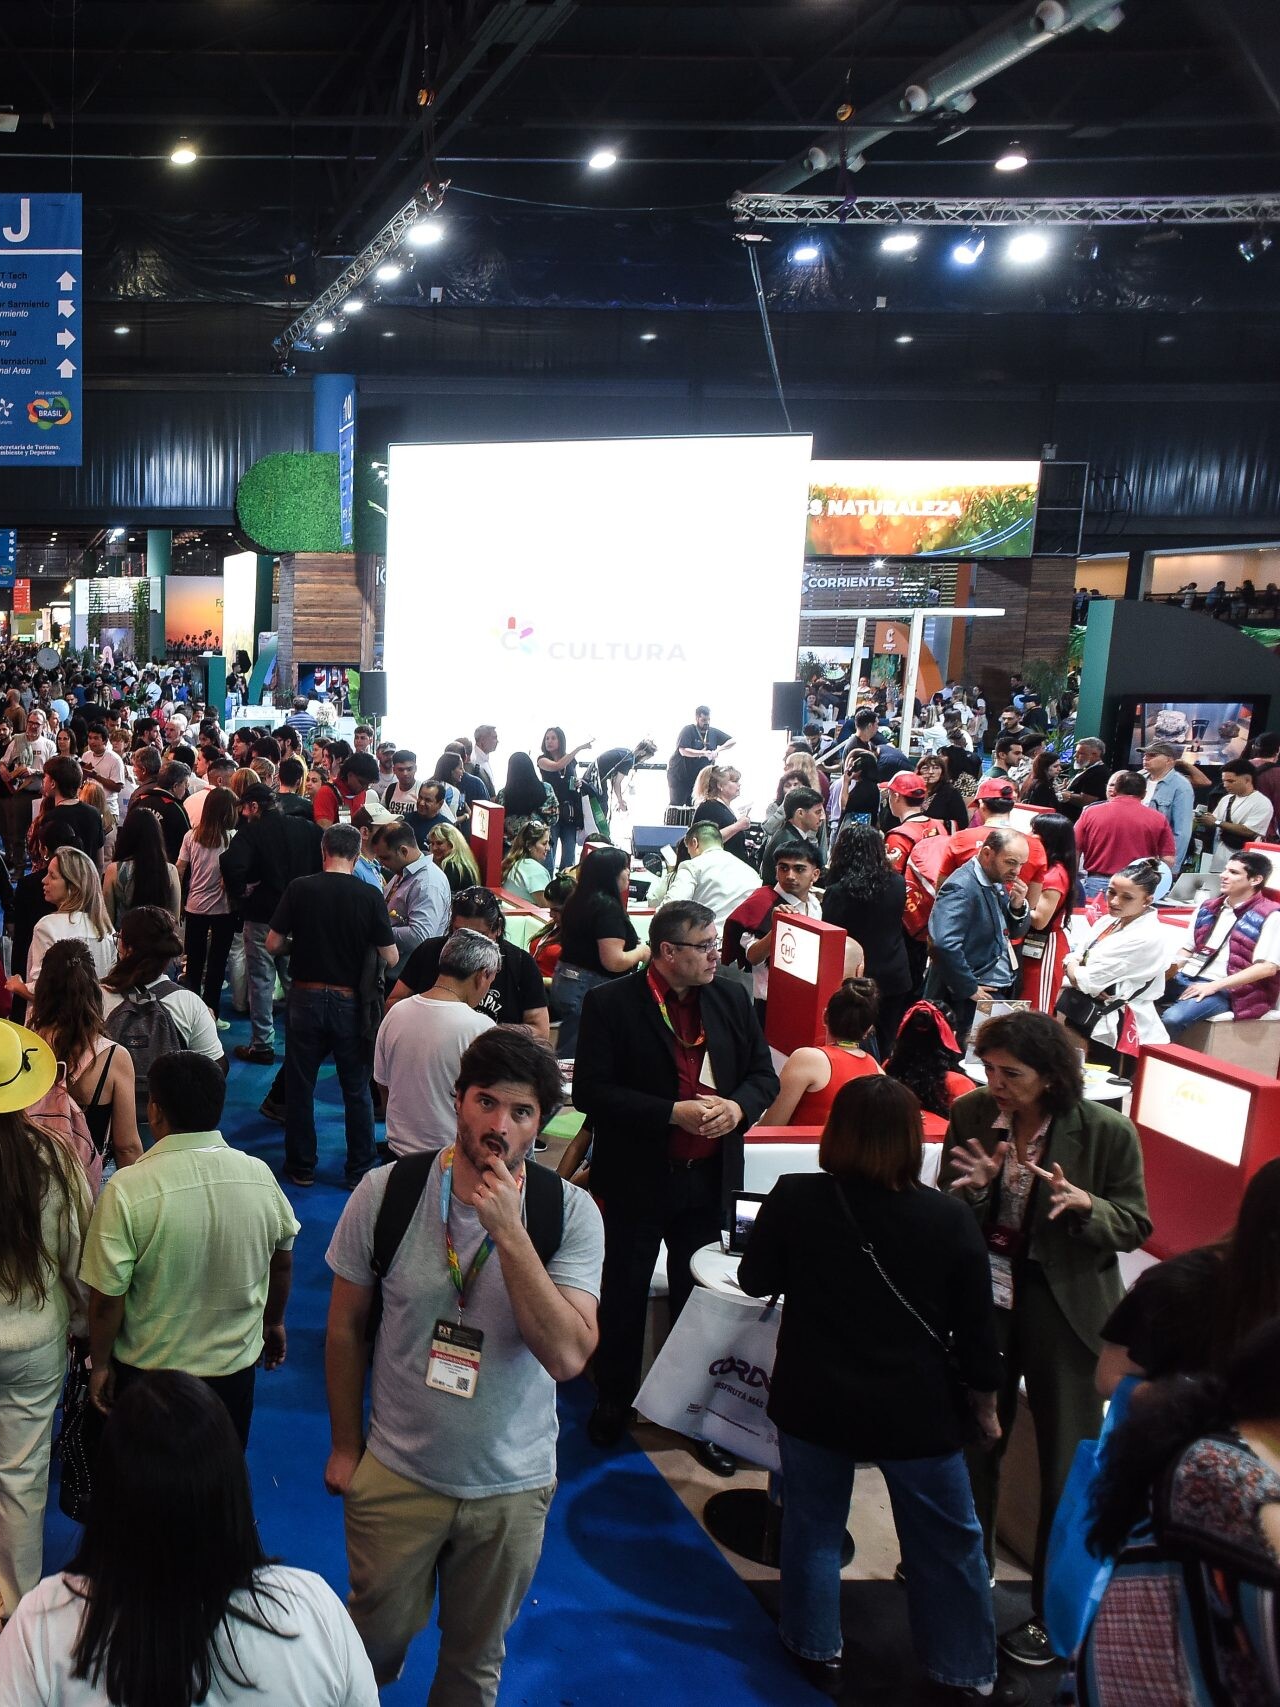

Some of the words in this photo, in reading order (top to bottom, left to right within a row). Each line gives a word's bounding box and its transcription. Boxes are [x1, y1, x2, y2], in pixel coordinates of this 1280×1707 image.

[2, 198, 31, 243] J
[8, 271, 28, 279] Tech
[7, 300, 50, 308] Sarmiento
[11, 367, 31, 375] Area
[38, 409, 63, 417] BRASIL
[828, 499, 962, 516] NATURALEZA
[808, 576, 895, 589] CORRIENTES
[548, 641, 688, 662] CULTURA
[709, 1356, 770, 1391] CÓRD
